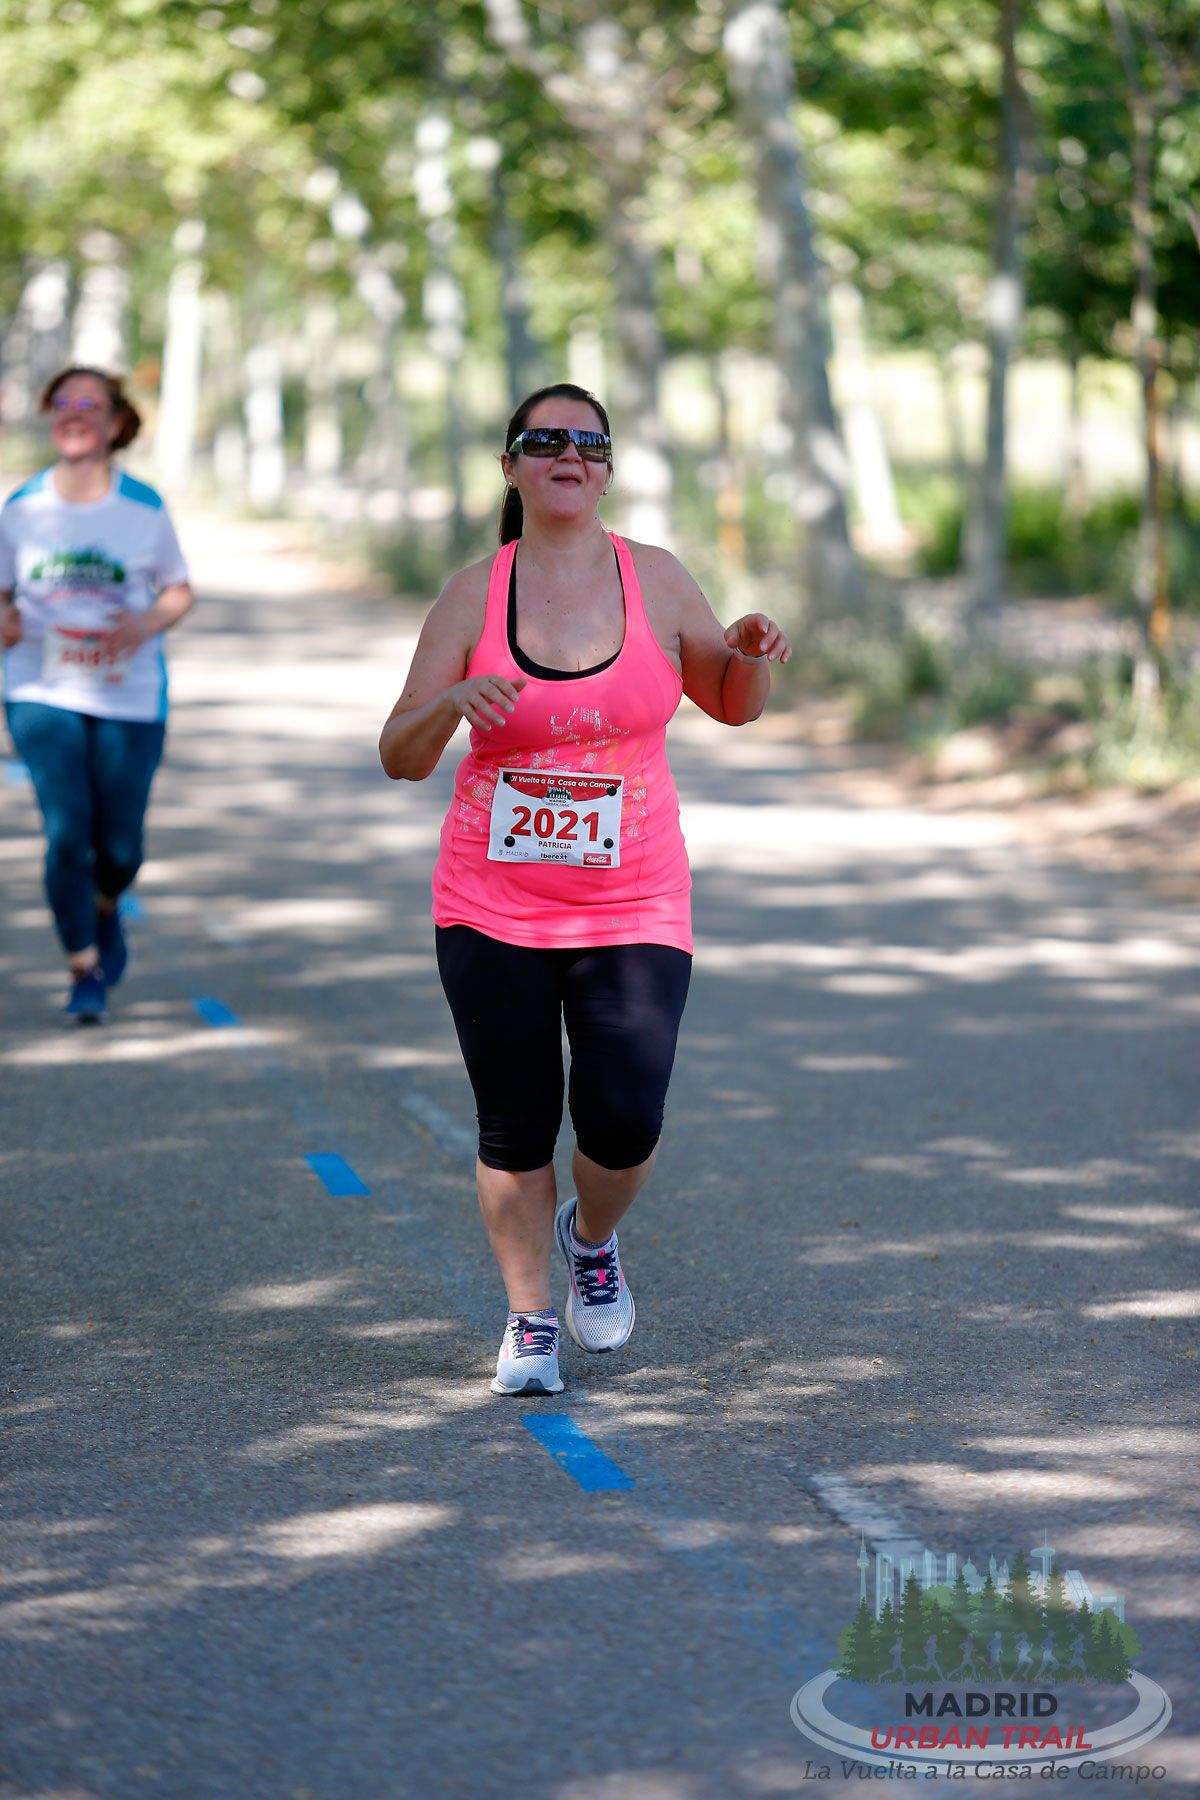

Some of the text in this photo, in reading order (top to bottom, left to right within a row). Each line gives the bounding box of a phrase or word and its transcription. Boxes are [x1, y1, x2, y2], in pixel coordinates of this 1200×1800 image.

[518, 775, 540, 784] Vuelta
[547, 777, 555, 785] la
[557, 778, 576, 787] Casa
[578, 780, 588, 788] de
[510, 805, 600, 842] 2021
[538, 841, 572, 850] PATRICIA
[505, 850, 529, 858] MADRID
